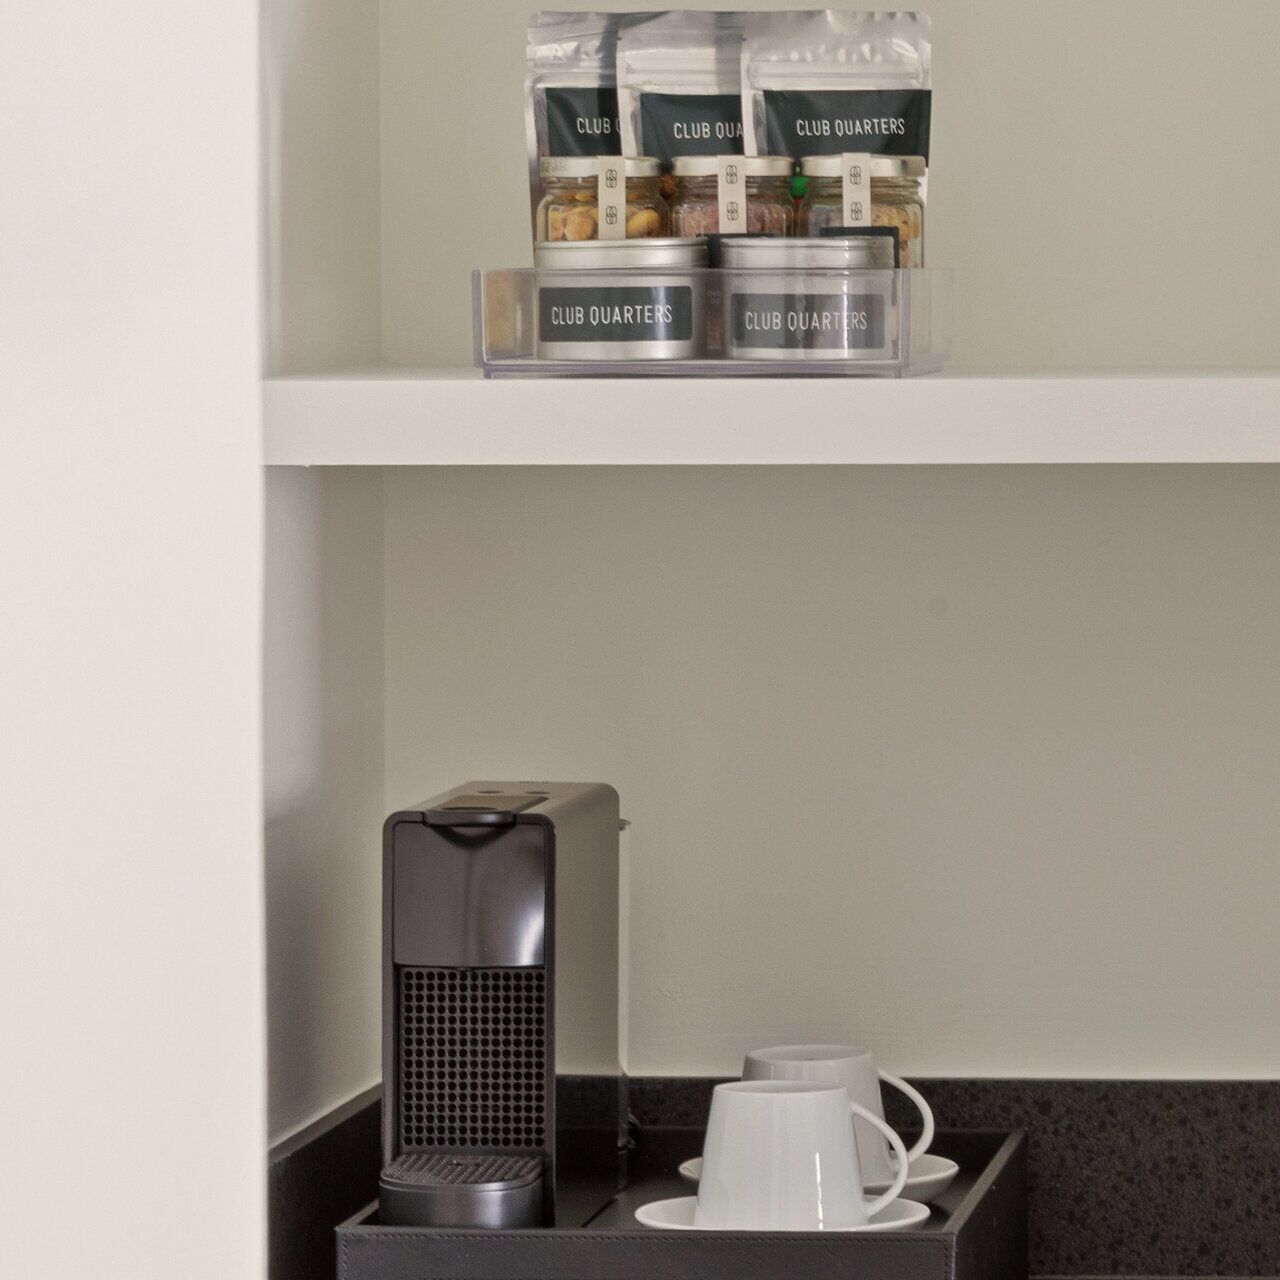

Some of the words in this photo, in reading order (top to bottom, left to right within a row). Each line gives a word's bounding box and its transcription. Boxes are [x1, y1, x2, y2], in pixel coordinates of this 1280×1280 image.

[577, 118, 611, 134] CLUB
[674, 122, 711, 139] CLUB
[796, 119, 831, 136] CLUB
[835, 118, 905, 136] QUARTERS
[552, 306, 585, 325] CLUB
[590, 305, 672, 326] QUARTERS
[745, 312, 782, 331] CLUB
[787, 311, 867, 332] QUARTERS
